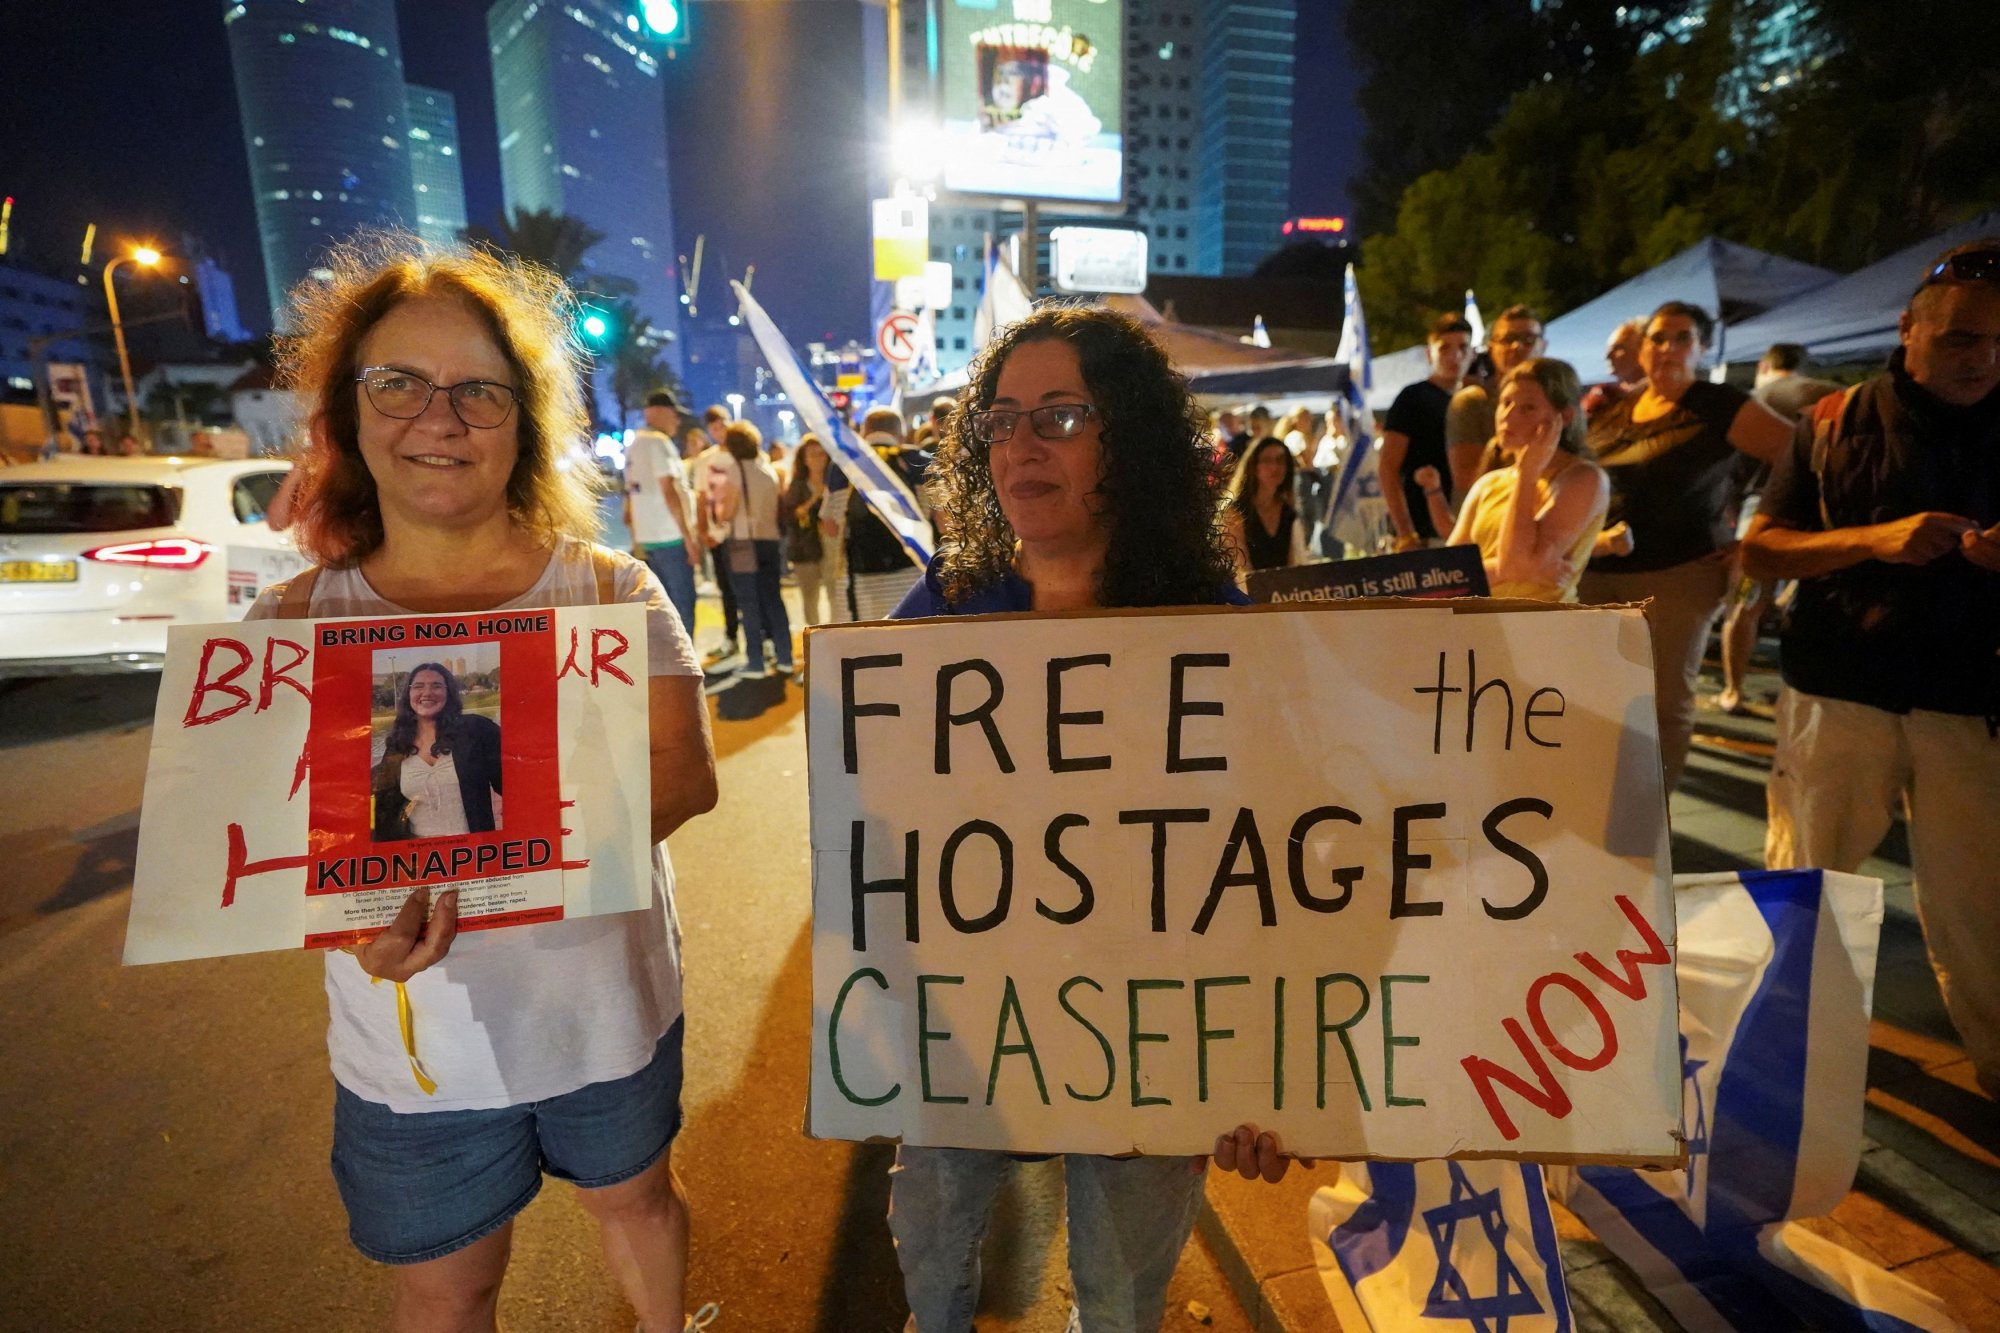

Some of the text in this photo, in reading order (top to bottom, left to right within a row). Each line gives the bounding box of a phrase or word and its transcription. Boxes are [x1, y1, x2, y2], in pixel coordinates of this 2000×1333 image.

[1362, 577, 1377, 594] is
[1382, 571, 1416, 594] still
[1421, 567, 1469, 588] alive.
[321, 616, 549, 646] BRING NOA HOME
[841, 650, 1565, 774] FREE the
[316, 838, 552, 890] KIDNAPPED
[850, 797, 1553, 951] HOSTAGES
[485, 875, 511, 884] abducted
[499, 892, 510, 900] age
[510, 890, 523, 898] from
[346, 914, 368, 923] months
[370, 919, 381, 927] and
[477, 908, 484, 916] by
[1460, 894, 1672, 1140] NOW
[828, 966, 1430, 1112] CEASEFIRE
